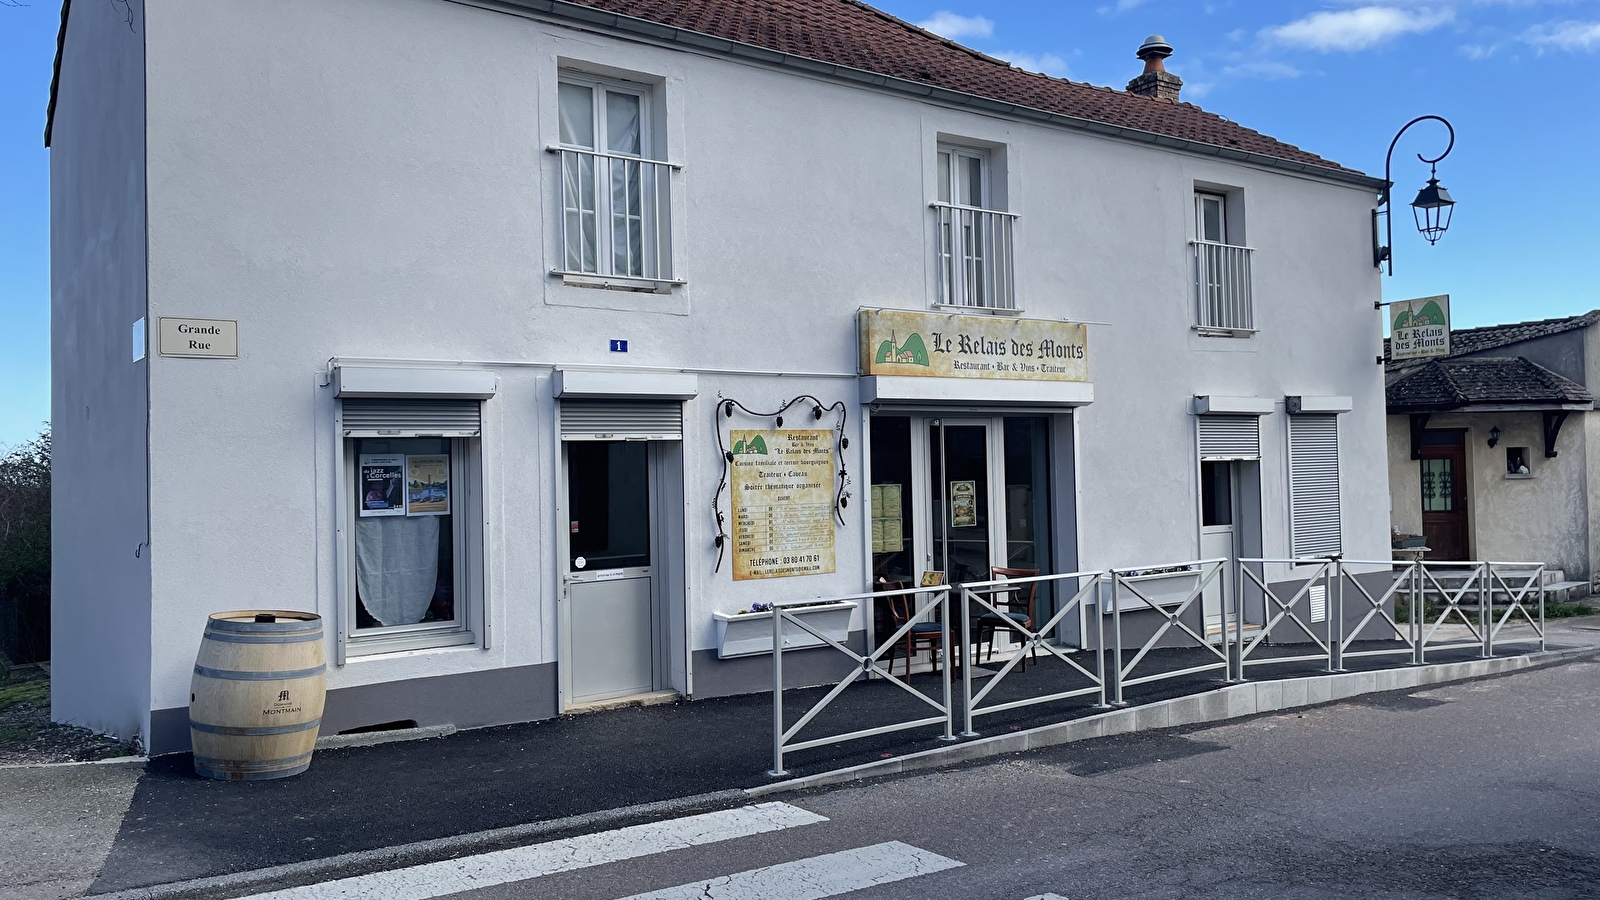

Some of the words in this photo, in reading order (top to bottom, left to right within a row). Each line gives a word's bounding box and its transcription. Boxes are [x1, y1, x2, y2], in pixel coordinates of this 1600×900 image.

[178, 324, 220, 334] Grande
[1397, 330, 1408, 340] Le
[1412, 328, 1443, 338] Relais
[189, 340, 210, 349] Rue
[617, 341, 621, 350] 1
[932, 332, 952, 353] Le
[958, 334, 1006, 356] Relais
[1011, 338, 1033, 357] des
[1038, 339, 1084, 360] Monts
[1395, 341, 1410, 350] des
[1413, 337, 1445, 349] Monts
[953, 360, 990, 371] Restaurant
[997, 362, 1009, 372] Bar
[1012, 363, 1018, 372] &
[1020, 363, 1035, 373] Vins
[1040, 364, 1066, 373] Traiteur
[262, 707, 301, 715] MONTMAIN
